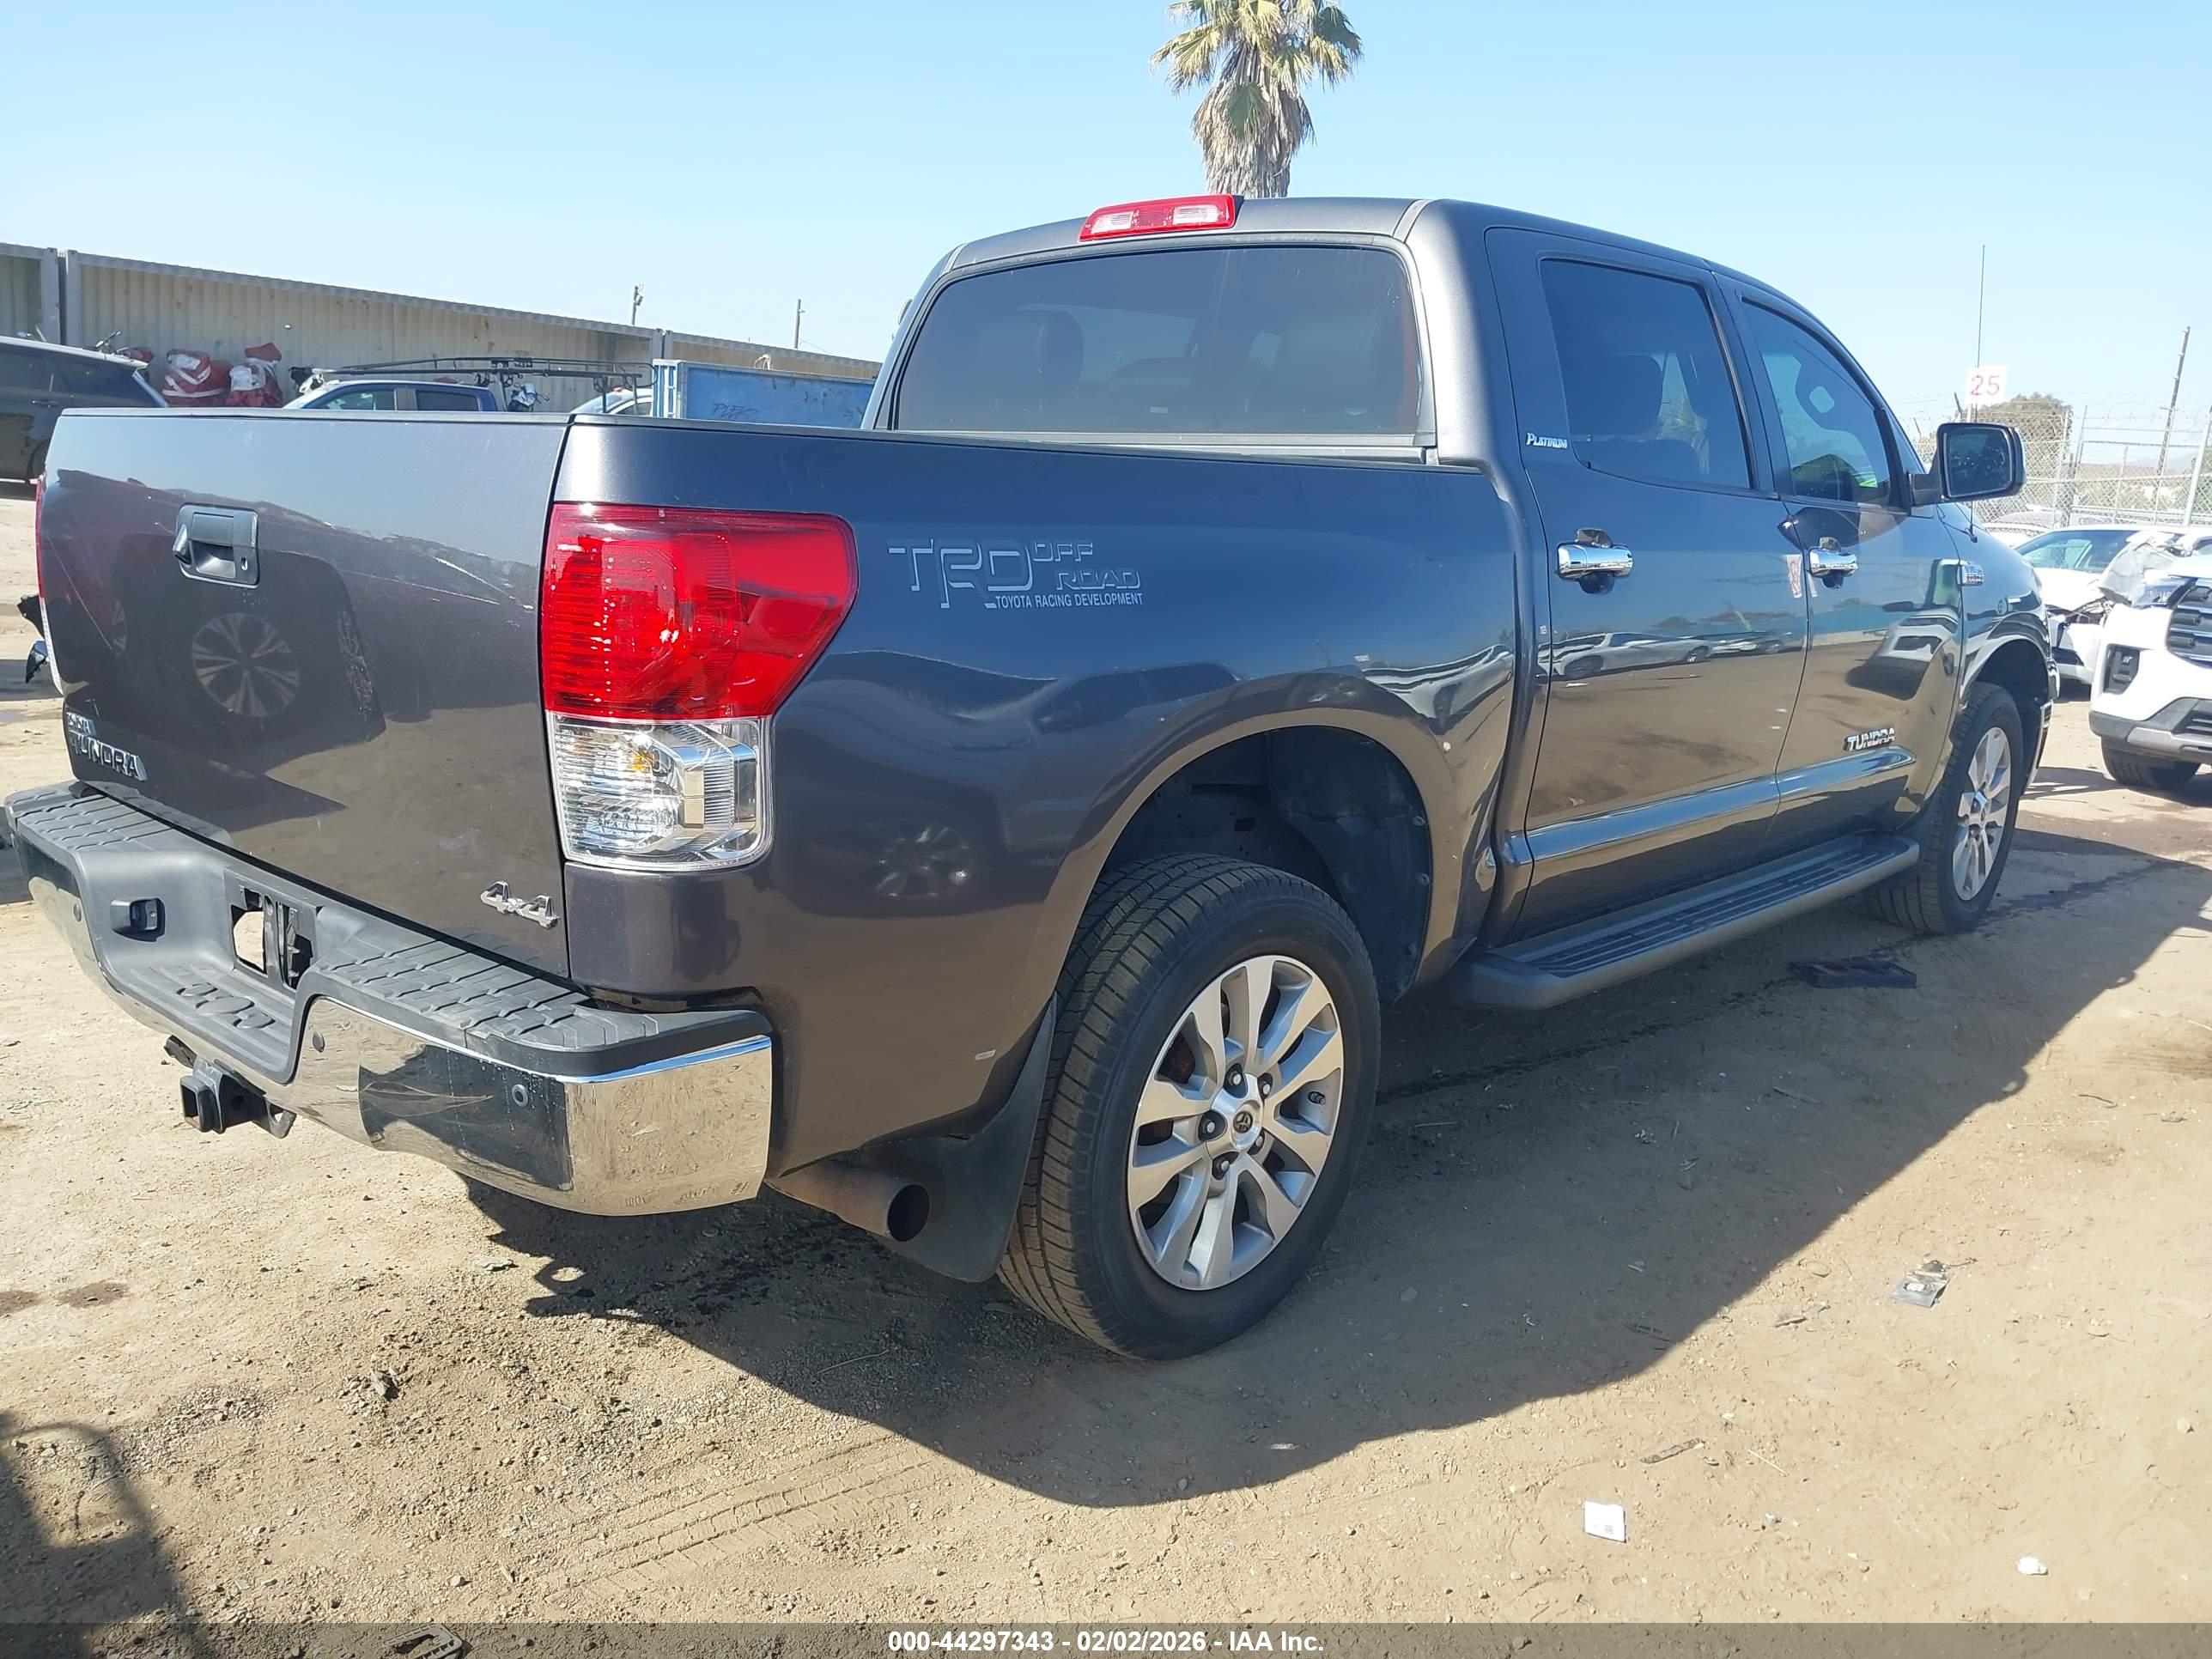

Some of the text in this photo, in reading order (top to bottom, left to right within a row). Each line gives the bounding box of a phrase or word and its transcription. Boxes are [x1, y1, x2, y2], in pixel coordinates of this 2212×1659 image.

[1970, 374, 2001, 396] 25
[1031, 541, 1095, 562] OFF
[887, 538, 1034, 609] TRD
[1056, 569, 1141, 590] ROAD
[994, 592, 1144, 610] TOYOTA RACING DEVELOPMENT
[1845, 726, 1896, 752] TUNDRA
[69, 729, 147, 781] TUNDRA
